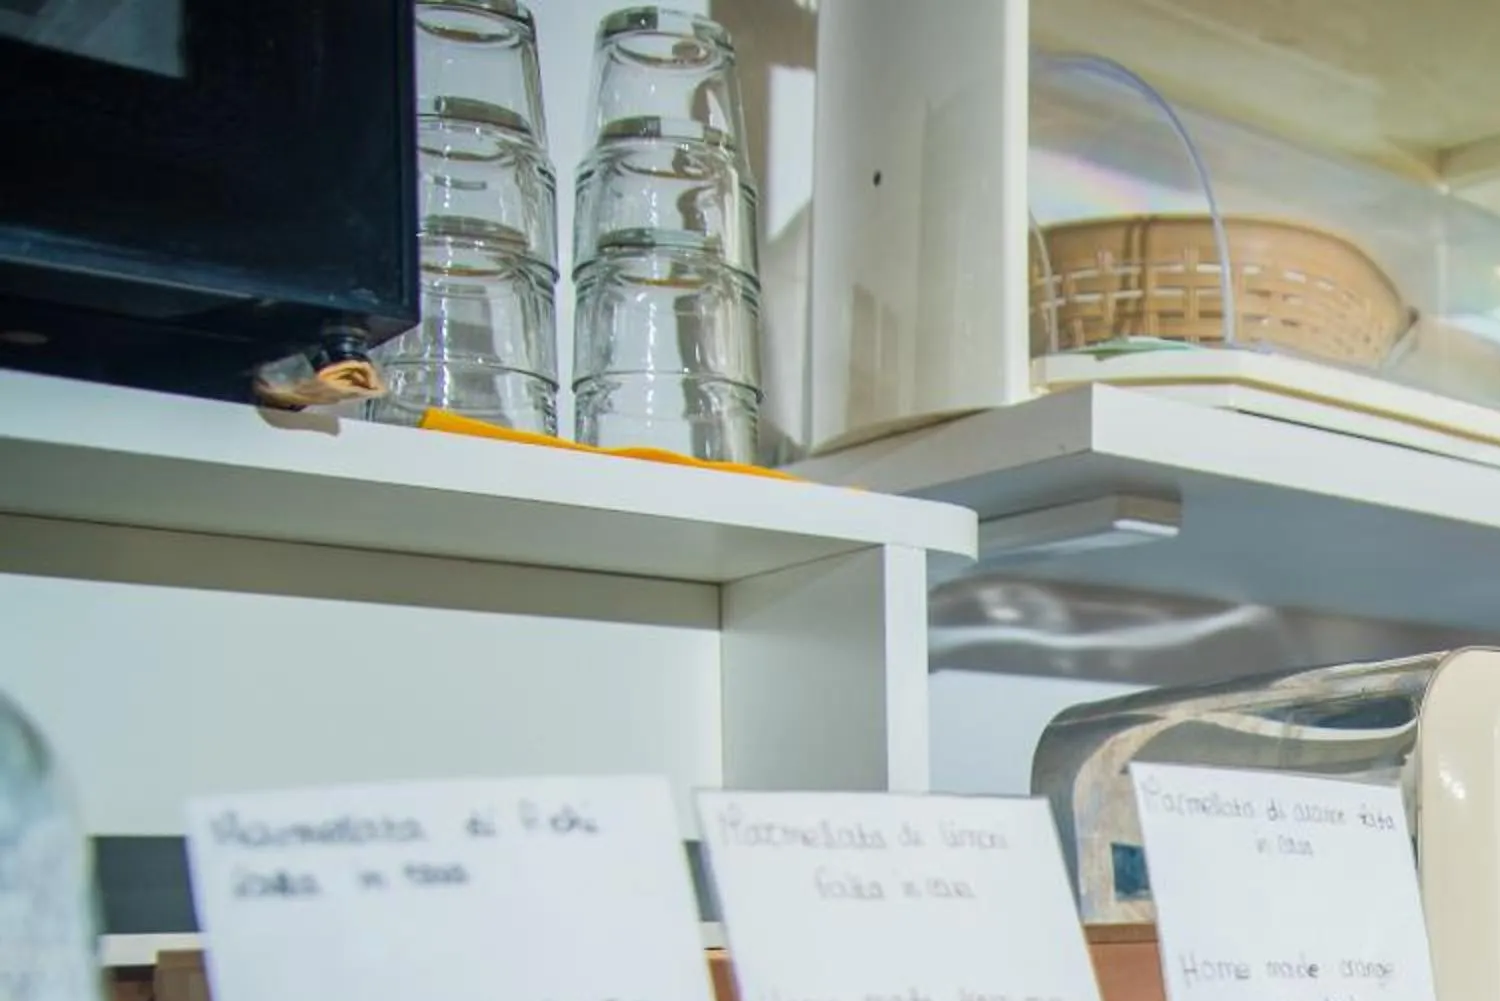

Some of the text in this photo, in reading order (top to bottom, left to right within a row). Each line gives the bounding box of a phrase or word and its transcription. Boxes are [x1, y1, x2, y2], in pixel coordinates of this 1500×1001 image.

[1266, 796, 1288, 822] di
[1178, 950, 1251, 990] Home
[1264, 950, 1320, 981] made
